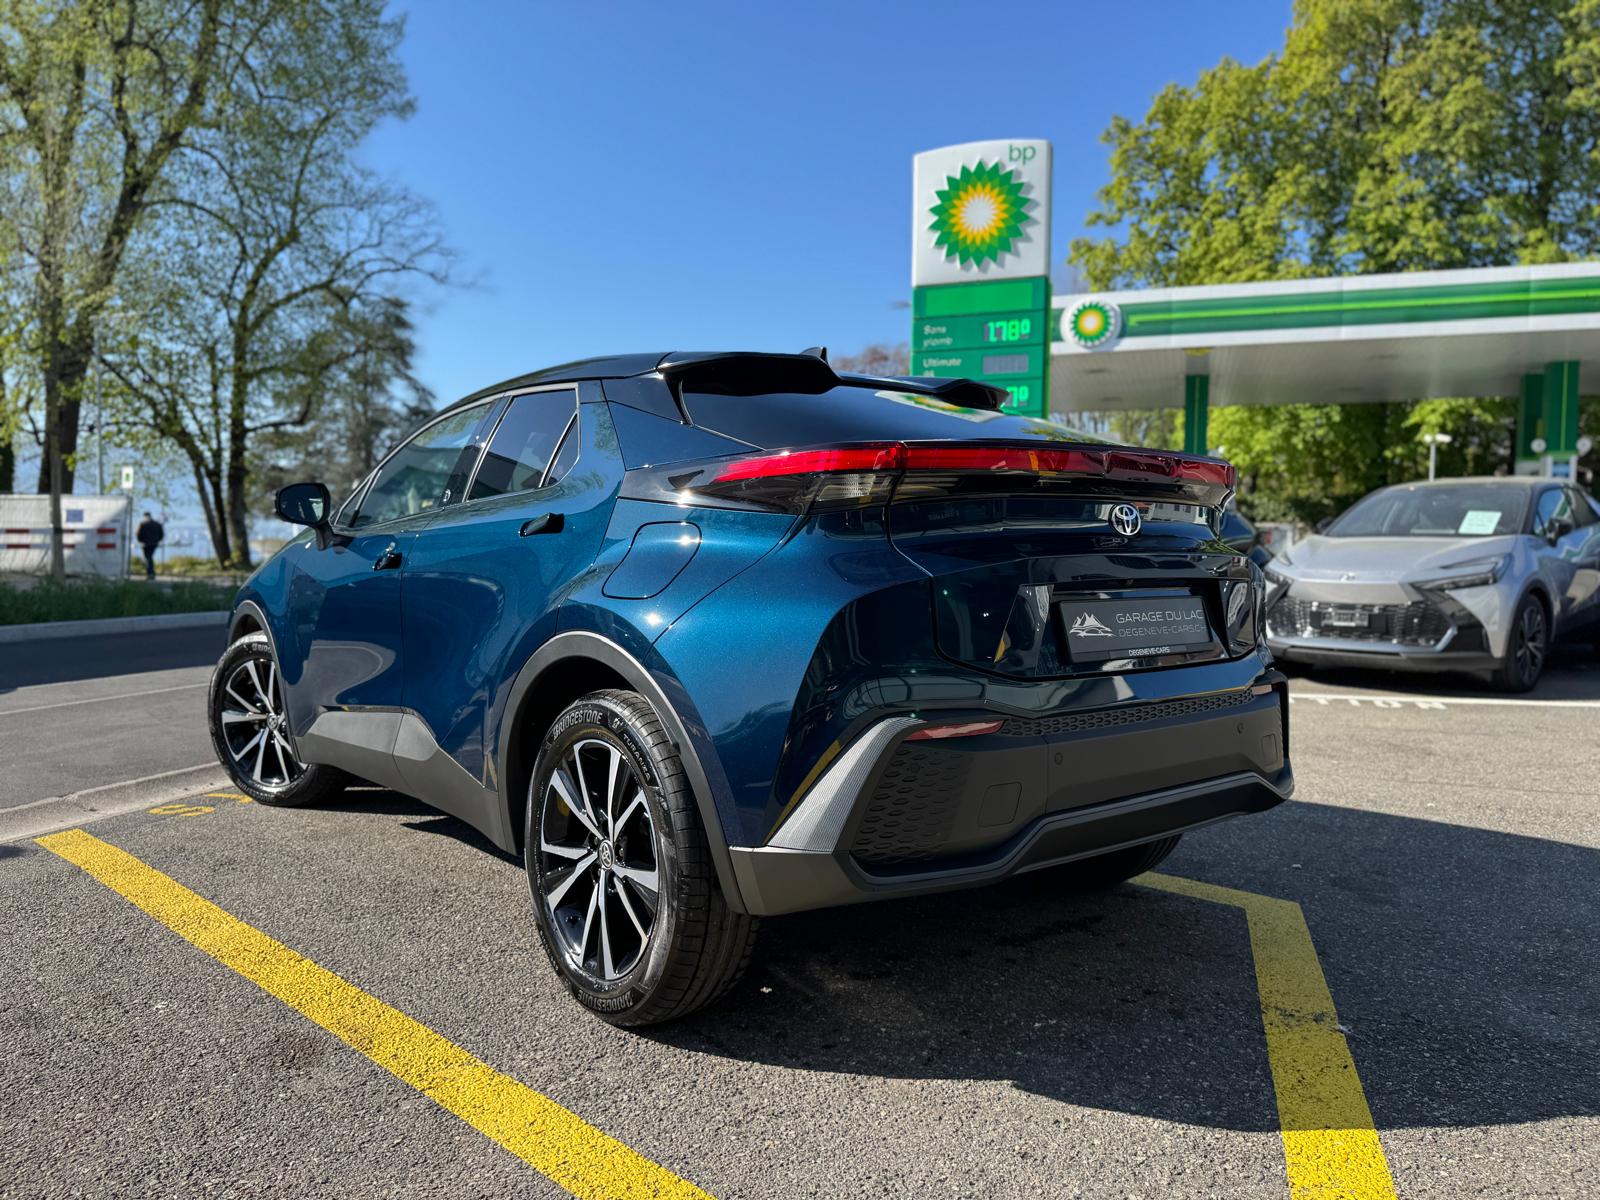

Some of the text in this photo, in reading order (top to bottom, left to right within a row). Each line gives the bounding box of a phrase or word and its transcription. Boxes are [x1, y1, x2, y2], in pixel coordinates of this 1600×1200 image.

[1009, 143, 1036, 164] bp
[1116, 609, 1204, 624] GARAGE DU LAC
[552, 709, 603, 741] BRIDGESTONE
[622, 733, 652, 781] TURANZA
